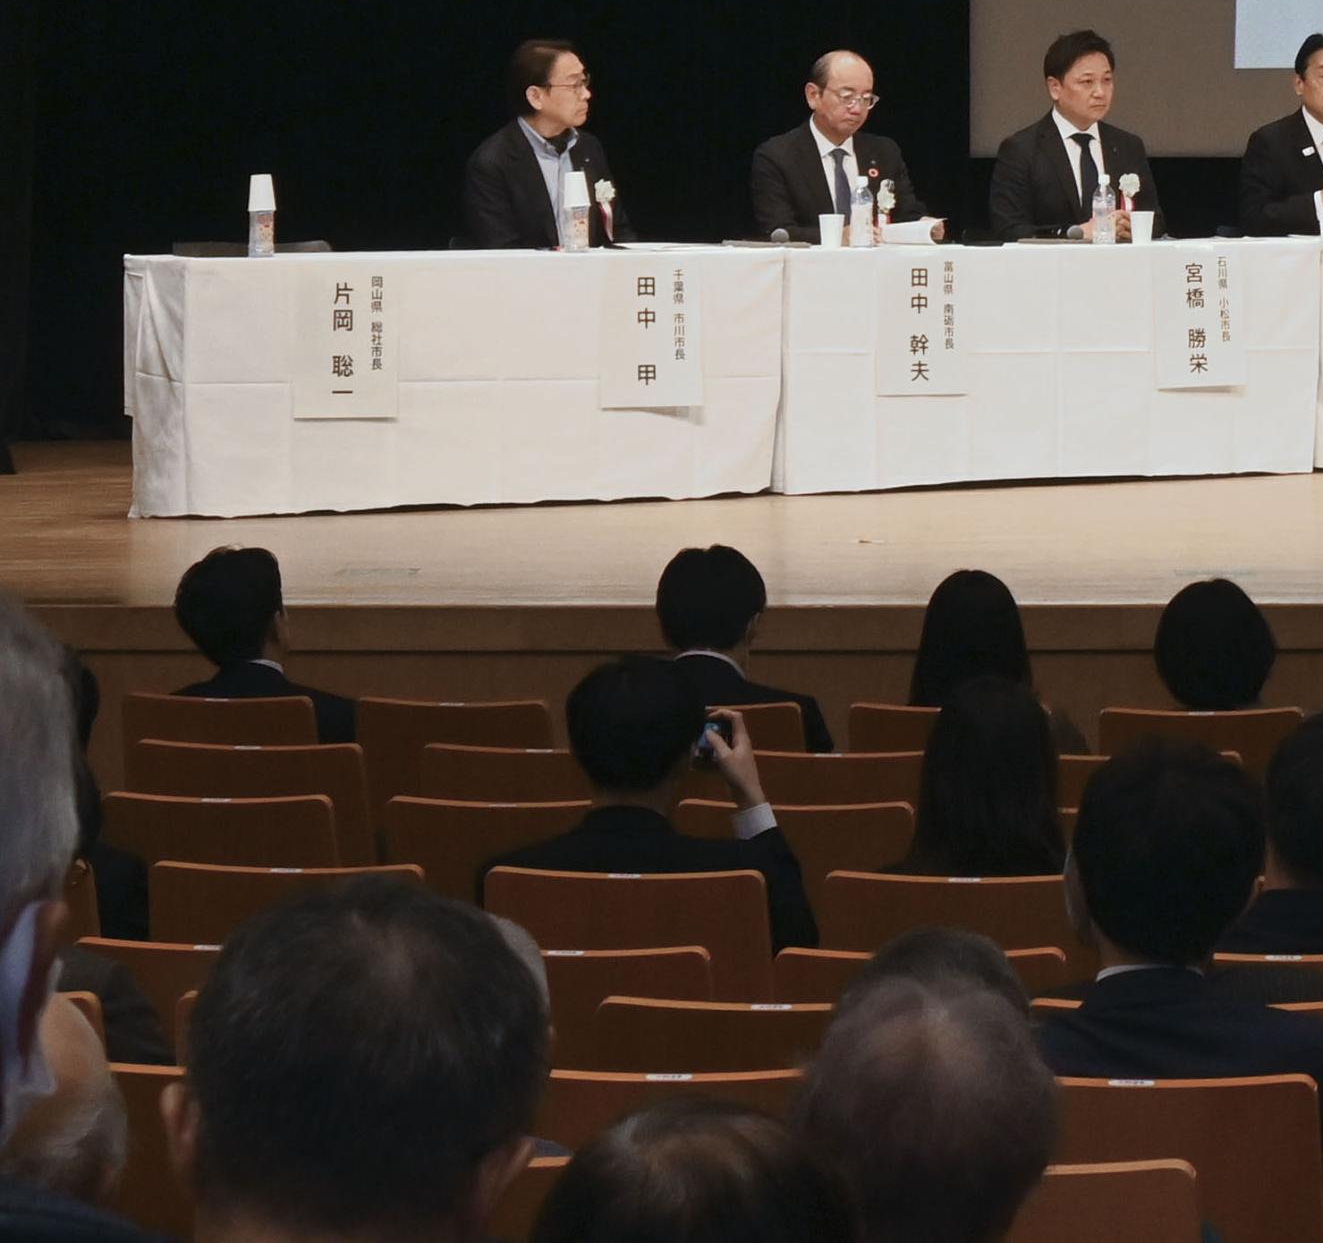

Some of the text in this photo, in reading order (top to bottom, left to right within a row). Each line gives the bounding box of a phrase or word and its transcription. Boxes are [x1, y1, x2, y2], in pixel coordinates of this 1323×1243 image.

[331, 281, 354, 395] 片岡 聡一
[370, 275, 384, 371] 岡山県 総社市長
[636, 276, 657, 386] 田中 甲
[672, 268, 686, 361] 千葉県 市川市長
[909, 267, 930, 382] 田中 幹夫
[1184, 262, 1209, 374] 宮橋 勝栄
[1217, 256, 1231, 343] 石川県 小松市長
